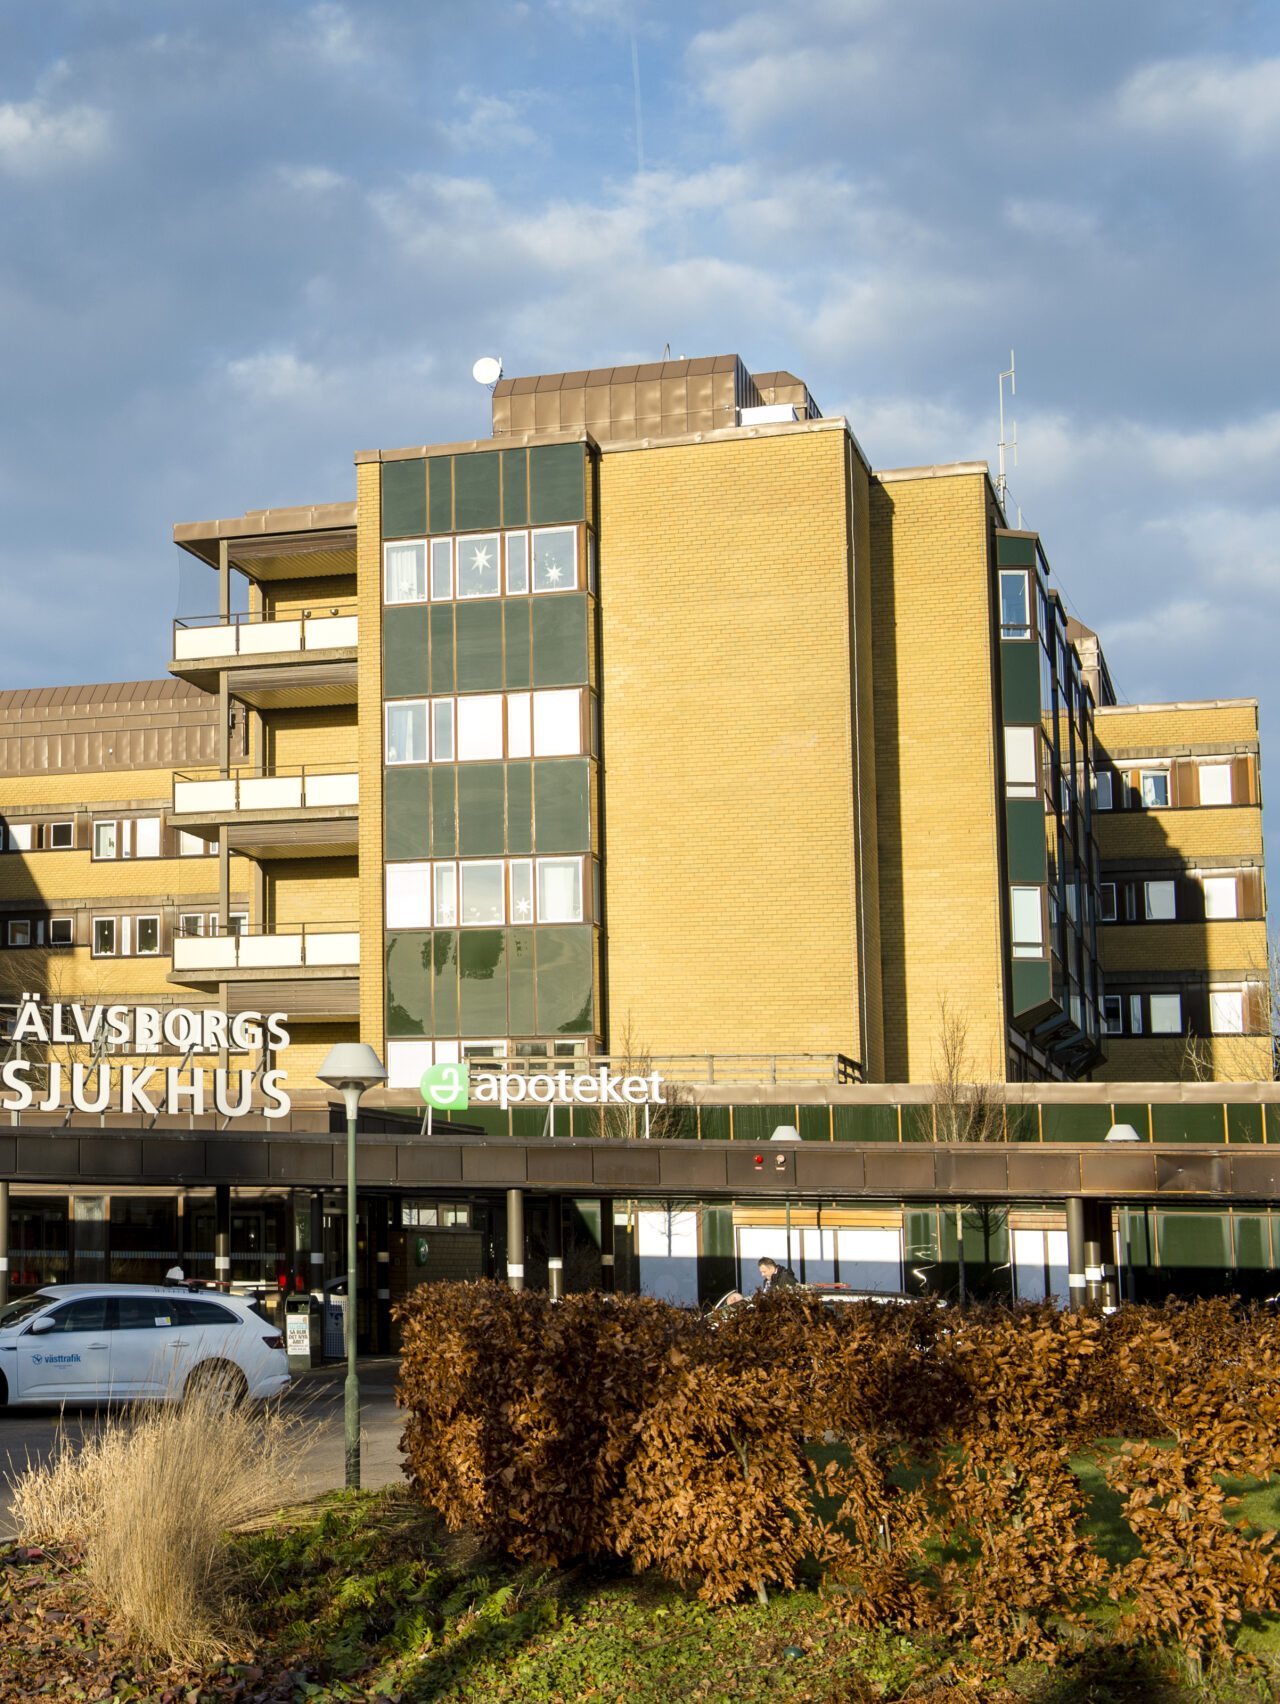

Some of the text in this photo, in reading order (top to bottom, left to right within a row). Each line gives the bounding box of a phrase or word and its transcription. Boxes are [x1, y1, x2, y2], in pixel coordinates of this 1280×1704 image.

[13, 992, 291, 1051] ÄLVSBORGS
[475, 1066, 667, 1110] apoteket
[44, 1353, 81, 1363] västtrafik
